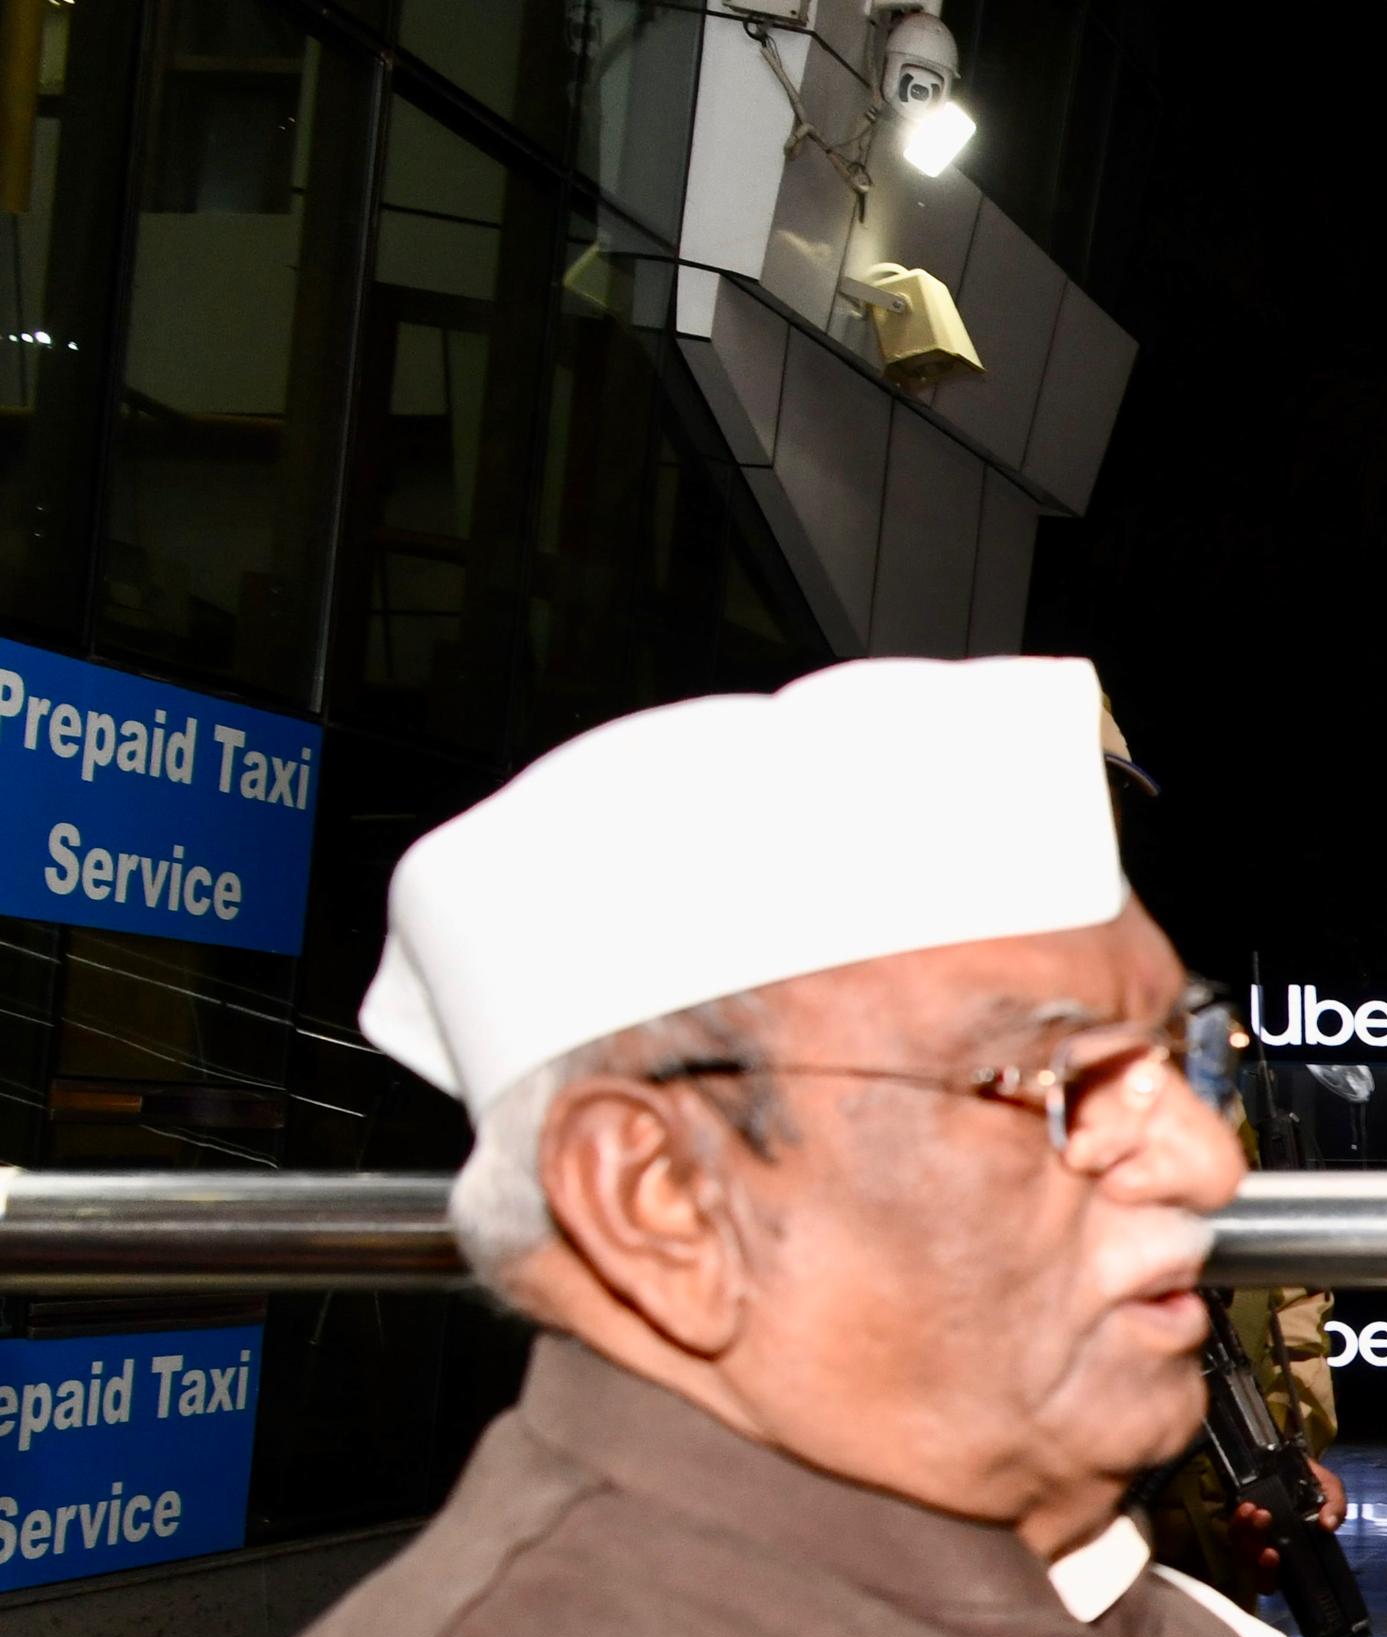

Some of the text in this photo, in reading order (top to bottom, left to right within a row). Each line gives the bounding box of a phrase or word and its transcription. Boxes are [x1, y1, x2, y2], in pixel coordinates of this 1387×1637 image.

[0, 668, 311, 810] Prepaid Taxi
[44, 823, 242, 921] Service
[152, 1350, 250, 1419] Taxi
